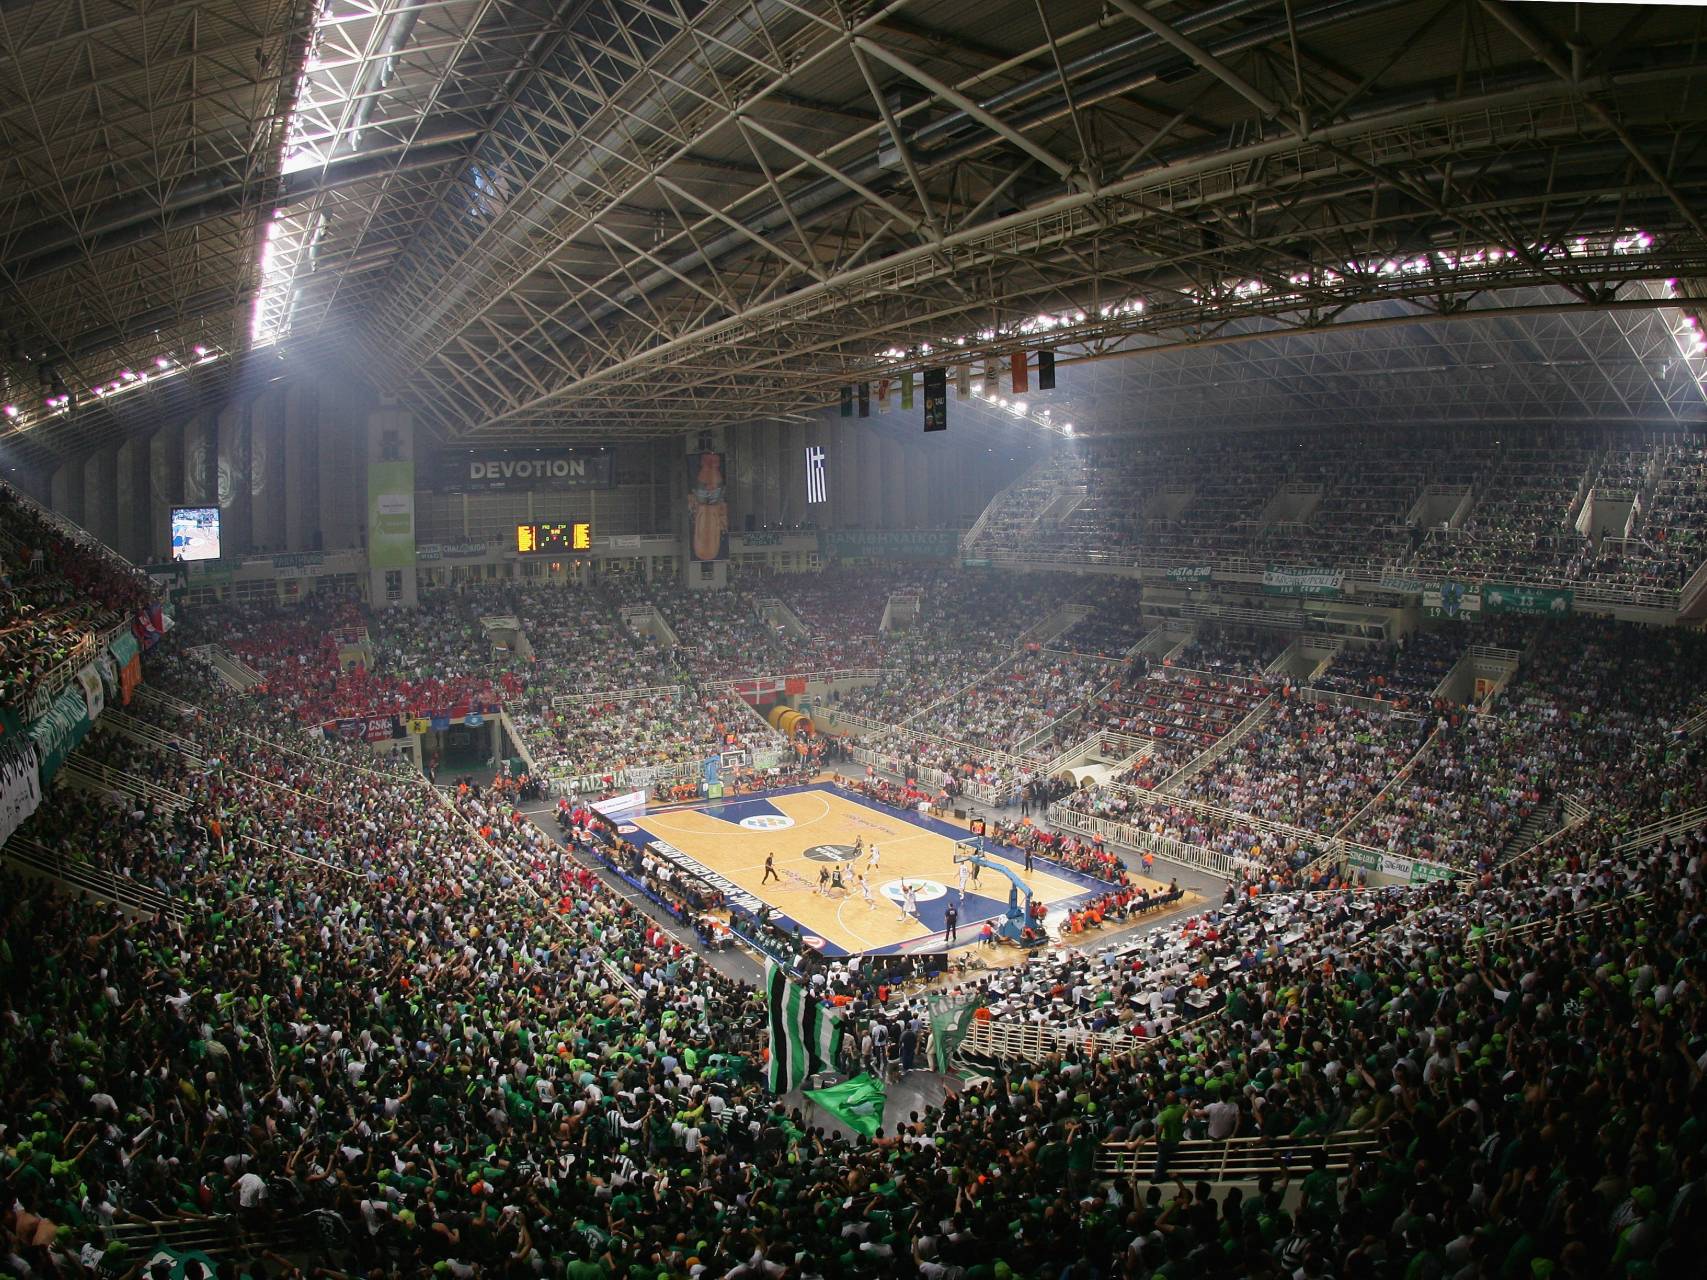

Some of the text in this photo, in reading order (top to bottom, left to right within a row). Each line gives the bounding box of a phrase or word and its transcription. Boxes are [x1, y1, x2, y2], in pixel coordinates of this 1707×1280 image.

[469, 459, 586, 480] DEVOTION
[1520, 596, 1534, 607] 13
[1430, 607, 1472, 622] 19 66
